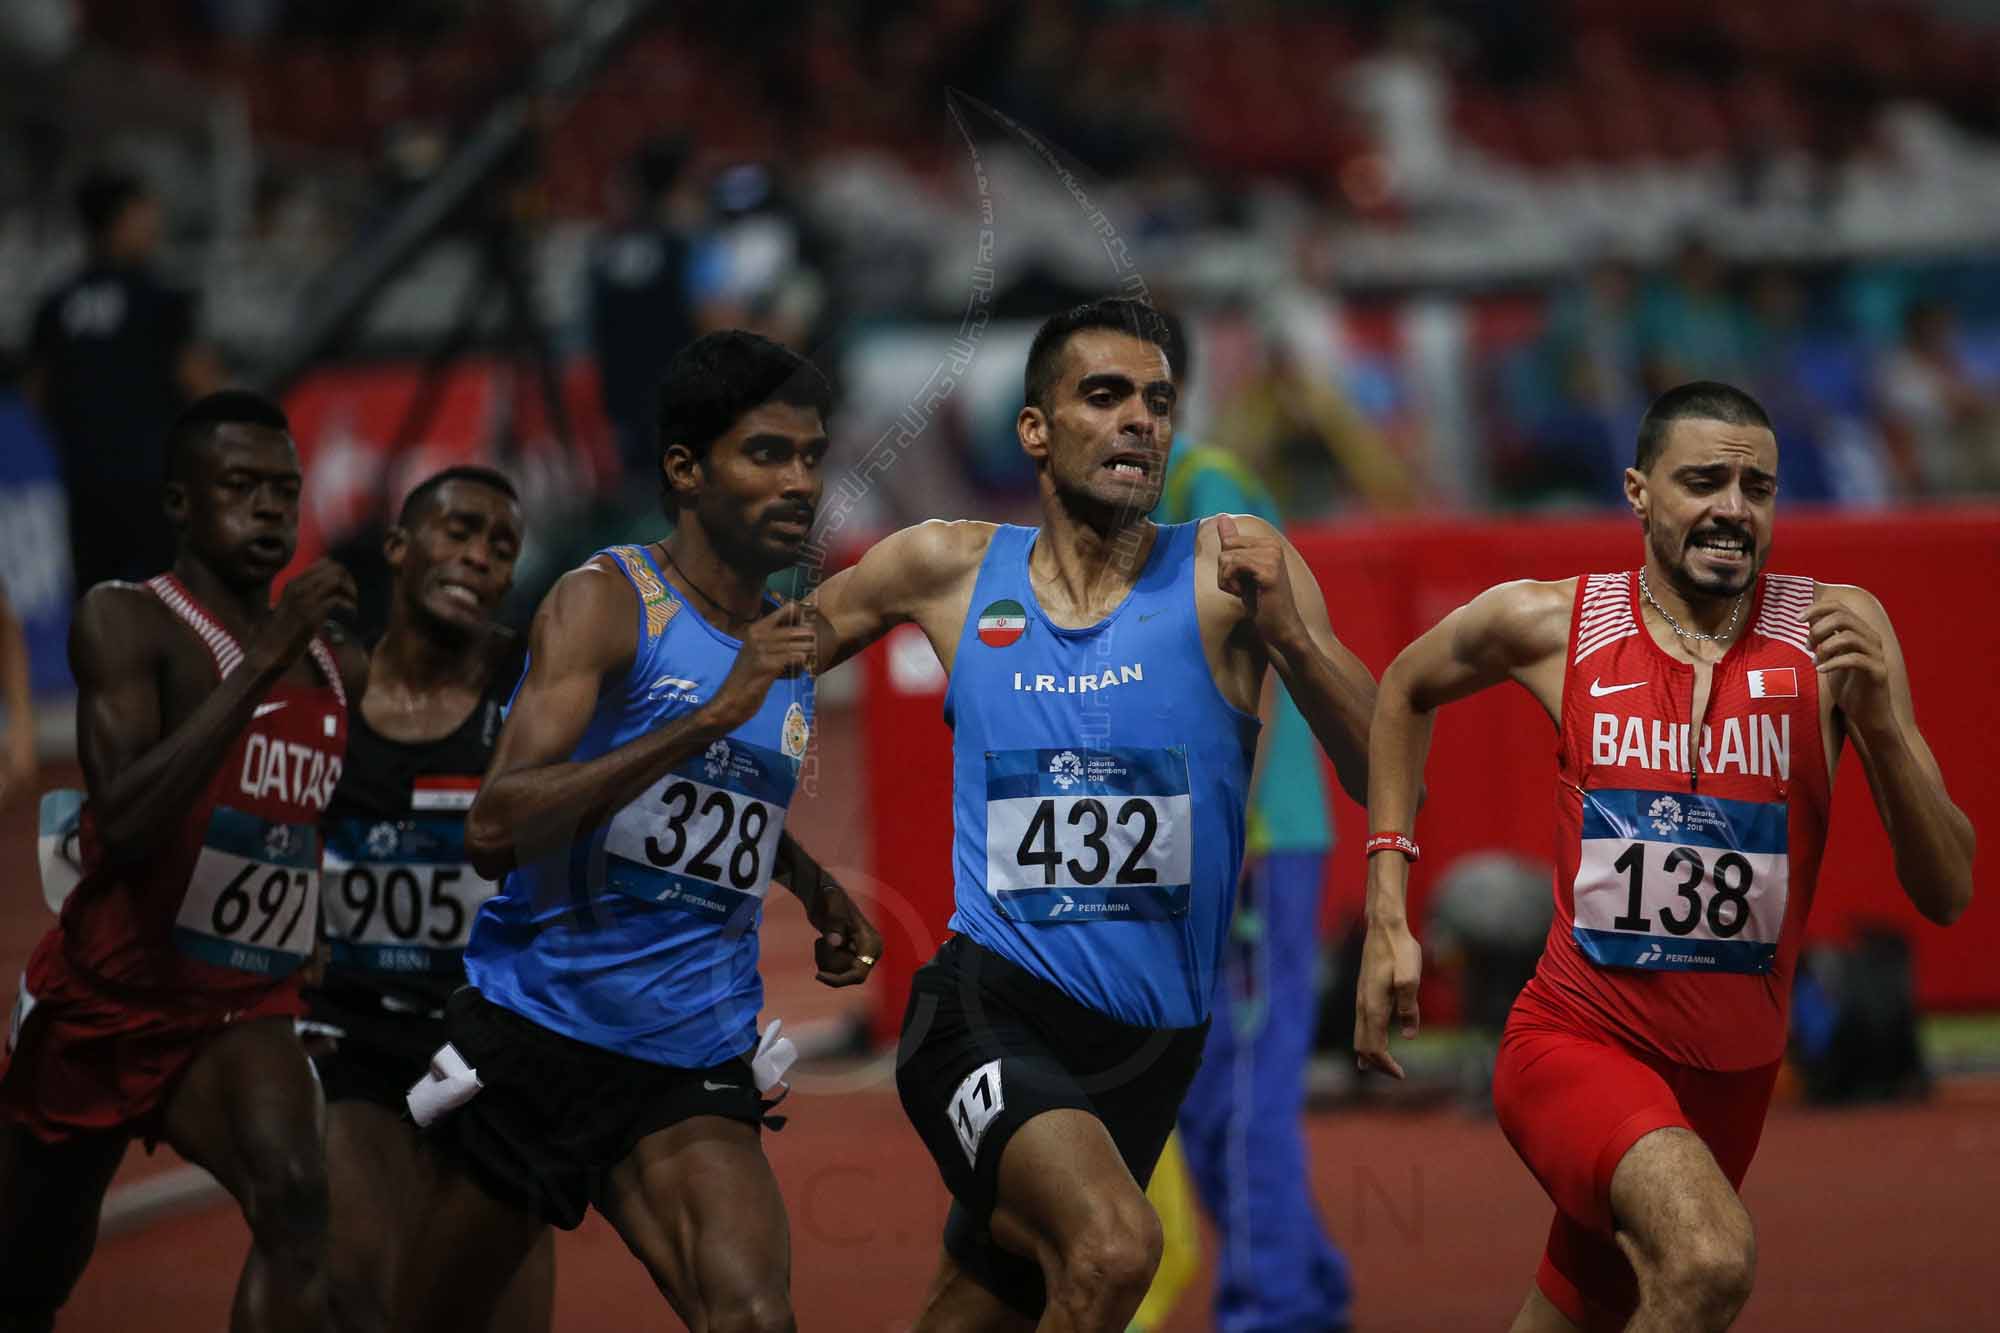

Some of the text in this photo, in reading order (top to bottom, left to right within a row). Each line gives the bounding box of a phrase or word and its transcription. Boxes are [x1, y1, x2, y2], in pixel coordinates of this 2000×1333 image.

[647, 692, 699, 704] L-NNG
[1013, 664, 1144, 695] I.R.IRAN
[1087, 767, 1127, 776] Palembang
[1592, 712, 1791, 781] BAHRAIN
[645, 780, 769, 890] 328
[1016, 797, 1159, 886] 432
[211, 862, 309, 948] 697
[341, 868, 466, 943] 905
[1078, 903, 1130, 913] PERTAMINA
[1613, 842, 1754, 939] 138
[1665, 953, 1716, 965] PERTAMINA
